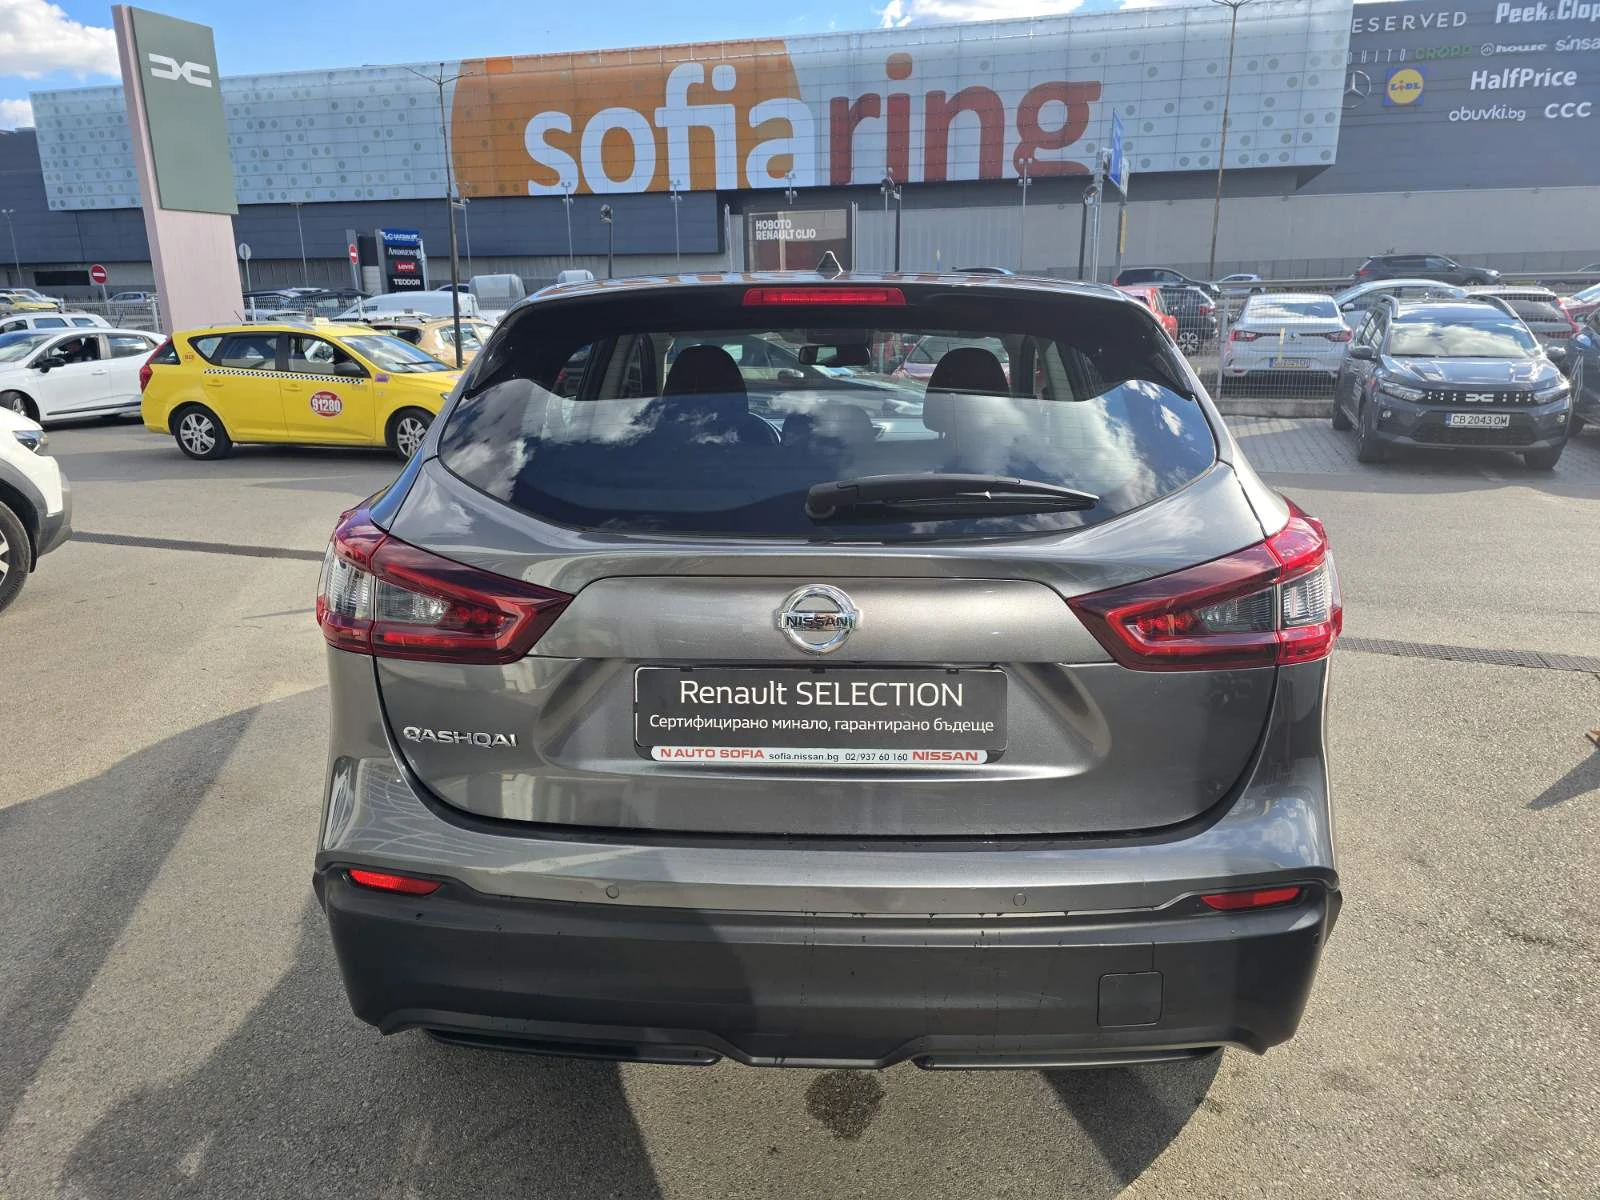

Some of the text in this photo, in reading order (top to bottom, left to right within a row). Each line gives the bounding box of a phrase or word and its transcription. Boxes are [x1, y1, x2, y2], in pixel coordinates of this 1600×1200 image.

[1470, 68, 1578, 91] HalfPrice
[1448, 104, 1527, 122] obuvki.bg
[1544, 102, 1593, 119] CCC
[756, 228, 816, 241] RENAULT CLIO
[311, 398, 342, 413] 91280
[1467, 415, 1493, 425] 2043
[786, 614, 848, 628] NISSAN
[679, 679, 963, 707] Renault SELECTION
[649, 714, 995, 734] Сертифицирано минало, гарантирано бъдеще
[403, 726, 517, 749] QASHQAI
[660, 748, 978, 762] N AUTO SOFIA sofia.nissan.bg 02/937 60 160 NISSAN
